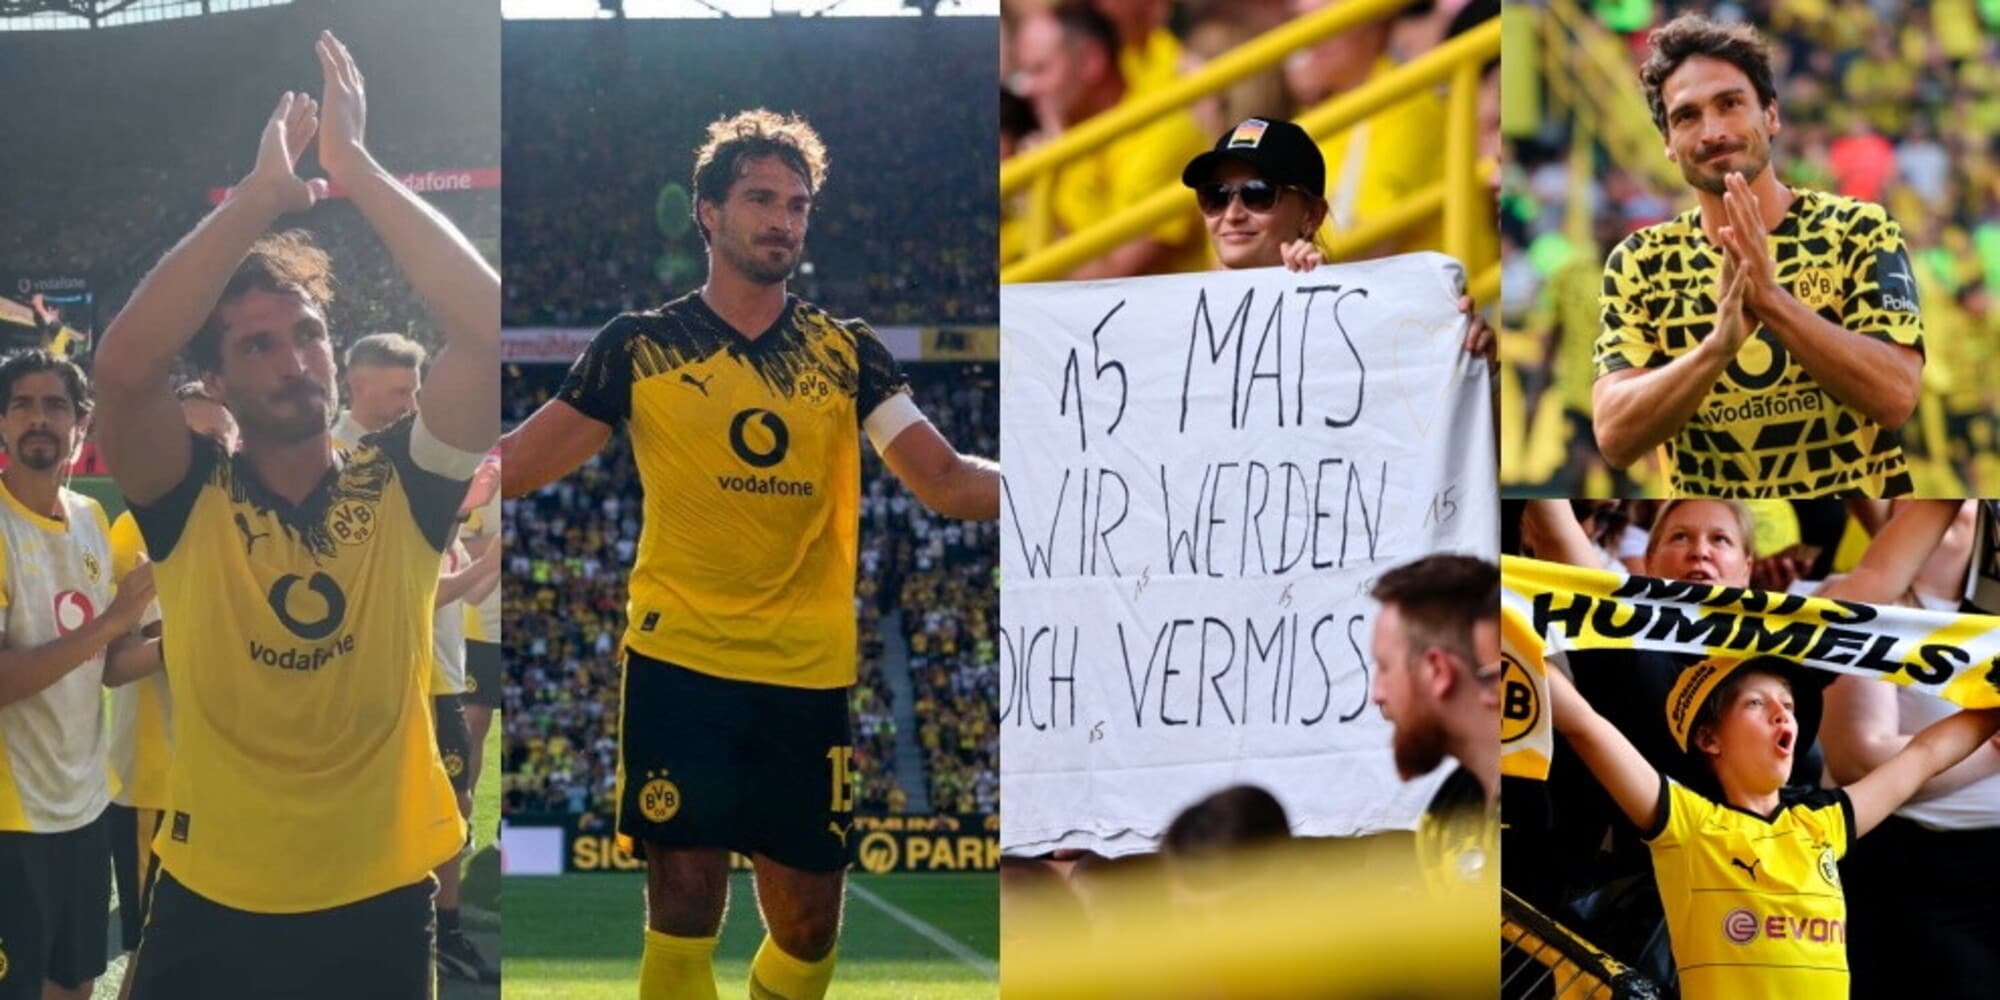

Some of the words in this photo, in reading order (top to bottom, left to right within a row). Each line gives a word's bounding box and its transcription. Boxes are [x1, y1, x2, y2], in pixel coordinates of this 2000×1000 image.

[1799, 271, 1831, 298] BVB
[1060, 298, 1128, 452] 15
[1179, 284, 1368, 434] MATS
[800, 375, 829, 397] BVB
[1709, 393, 1817, 424] vodafone
[718, 474, 814, 496] vodafone
[333, 504, 371, 540] BVB
[1001, 468, 1130, 579] WIR
[1161, 458, 1387, 577] WERDEN
[1532, 592, 1970, 685] HUMMELS
[646, 784, 676, 810] BVB
[906, 837, 1000, 870] PARK
